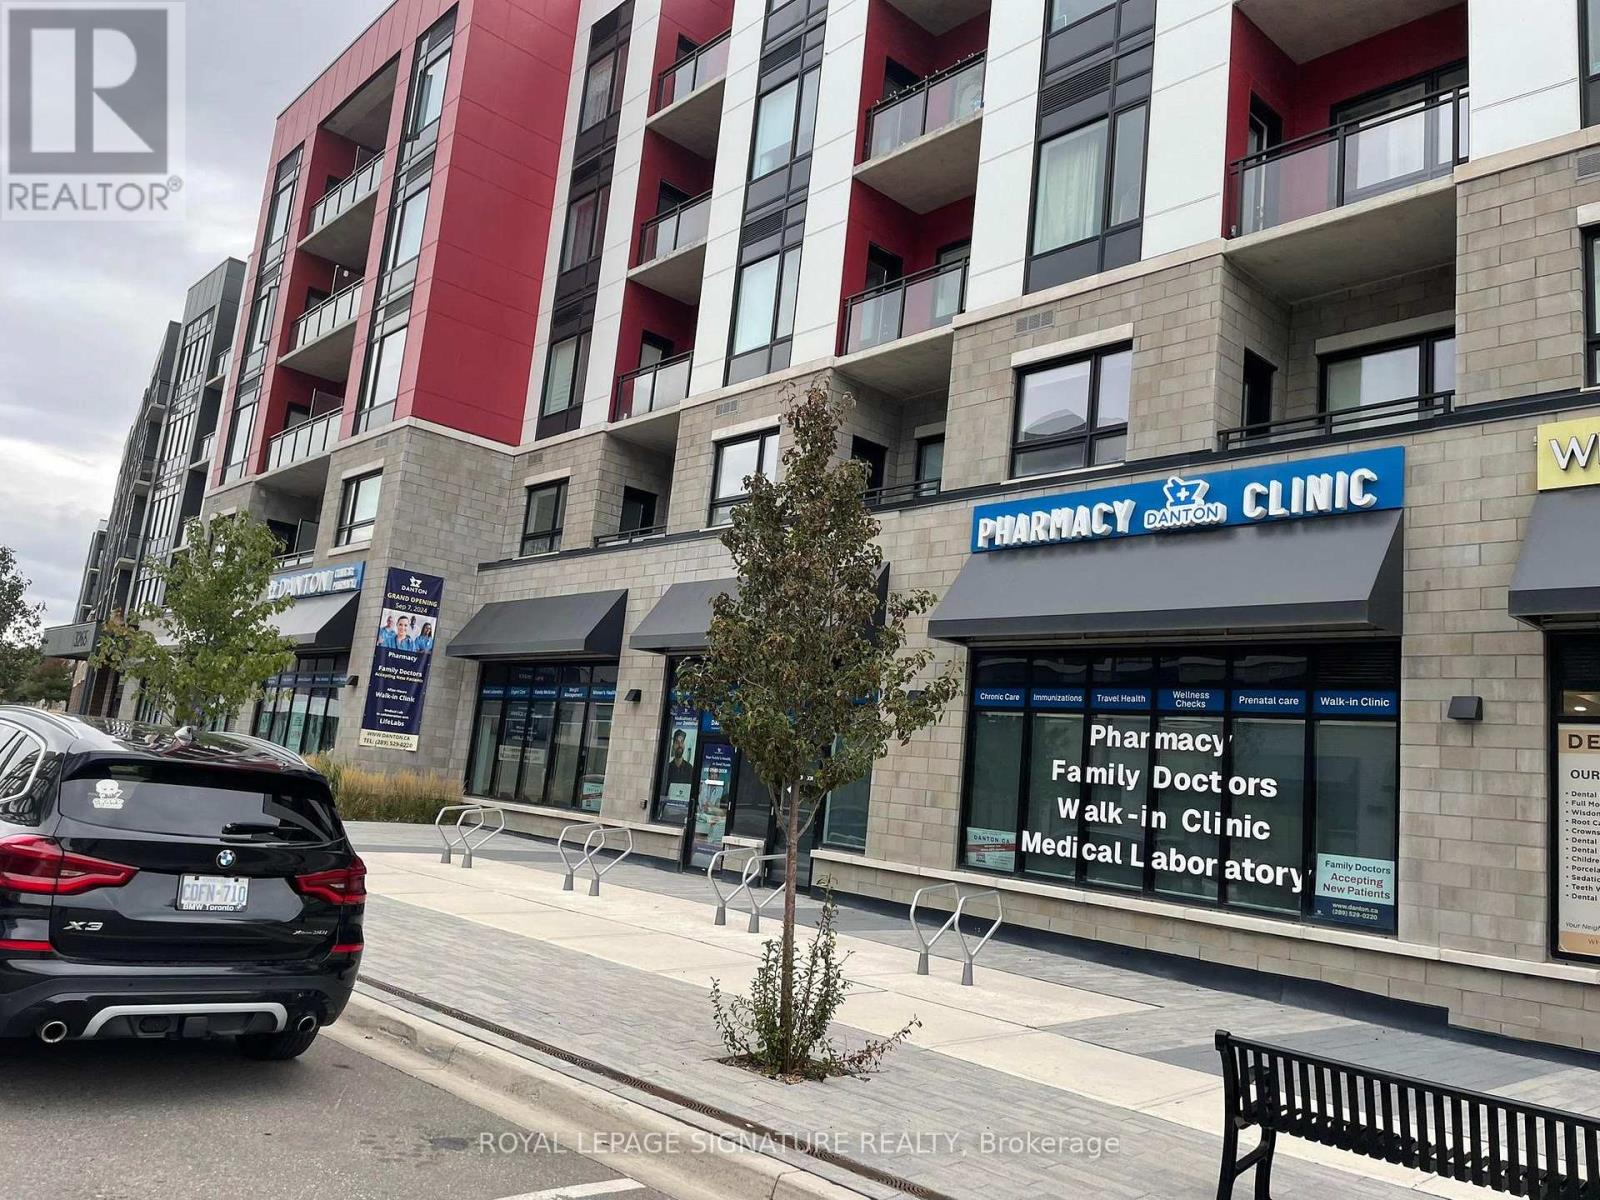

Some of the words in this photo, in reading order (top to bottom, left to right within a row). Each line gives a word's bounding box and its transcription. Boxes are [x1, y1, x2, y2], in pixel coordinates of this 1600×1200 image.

[1549, 432, 1600, 471] W
[977, 499, 1136, 548] PHARMACY
[1145, 504, 1221, 527] DANTON
[1242, 467, 1378, 518] CLINIC
[401, 585, 428, 595] DANTON
[387, 592, 410, 602] GRAND
[410, 597, 438, 608] OPENING
[395, 603, 407, 611] Sep
[413, 606, 428, 614] 2024
[388, 652, 417, 662] Pharmacy
[378, 665, 398, 675] Family
[399, 669, 422, 677] Doctors
[375, 692, 398, 701] Walk-in
[399, 694, 415, 703] Clinic
[980, 692, 1003, 701] Chronic
[1005, 693, 1020, 701] Care
[1033, 693, 1082, 703] Immunizations
[1097, 694, 1120, 703] Travel
[1121, 694, 1146, 703] Health
[1172, 690, 1210, 699] Wellness
[1175, 699, 1206, 709] Checks
[1239, 696, 1277, 705] Prenatal
[1278, 697, 1299, 706] care
[1320, 696, 1359, 707] Walk-in
[1361, 697, 1390, 707] Clinic
[379, 718, 404, 727] LifeLabs
[1090, 724, 1233, 757] Pharmacy
[1051, 759, 1141, 791] Family
[1153, 765, 1278, 798] Doctors
[1570, 769, 1600, 780] OUR
[1571, 790, 1597, 798] Dental
[1057, 797, 1166, 829] Walk-in
[1181, 808, 1271, 840] Clinic
[1571, 818, 1590, 826] Root
[1571, 828, 1600, 836] Crowns
[1571, 837, 1597, 845] Dental
[1571, 846, 1597, 854] Dental
[1021, 830, 1122, 864] Medical
[1130, 842, 1313, 893] Laboratory
[1571, 855, 1600, 864] Childre
[1325, 860, 1354, 871] Family
[1355, 863, 1391, 875] Doctors
[1330, 872, 1384, 888] Accepting
[1323, 883, 1345, 893] New
[1347, 886, 1391, 900] Patients
[1572, 884, 1593, 892] Teeth
[1571, 893, 1597, 902] Dental
[183, 903, 203, 911] BMW
[204, 903, 234, 911] Toronto
[1332, 903, 1379, 914] www.danton.ca
[1332, 908, 1348, 917] (289)
[1348, 910, 1378, 920] 529-0220
[63, 921, 103, 930] X3
